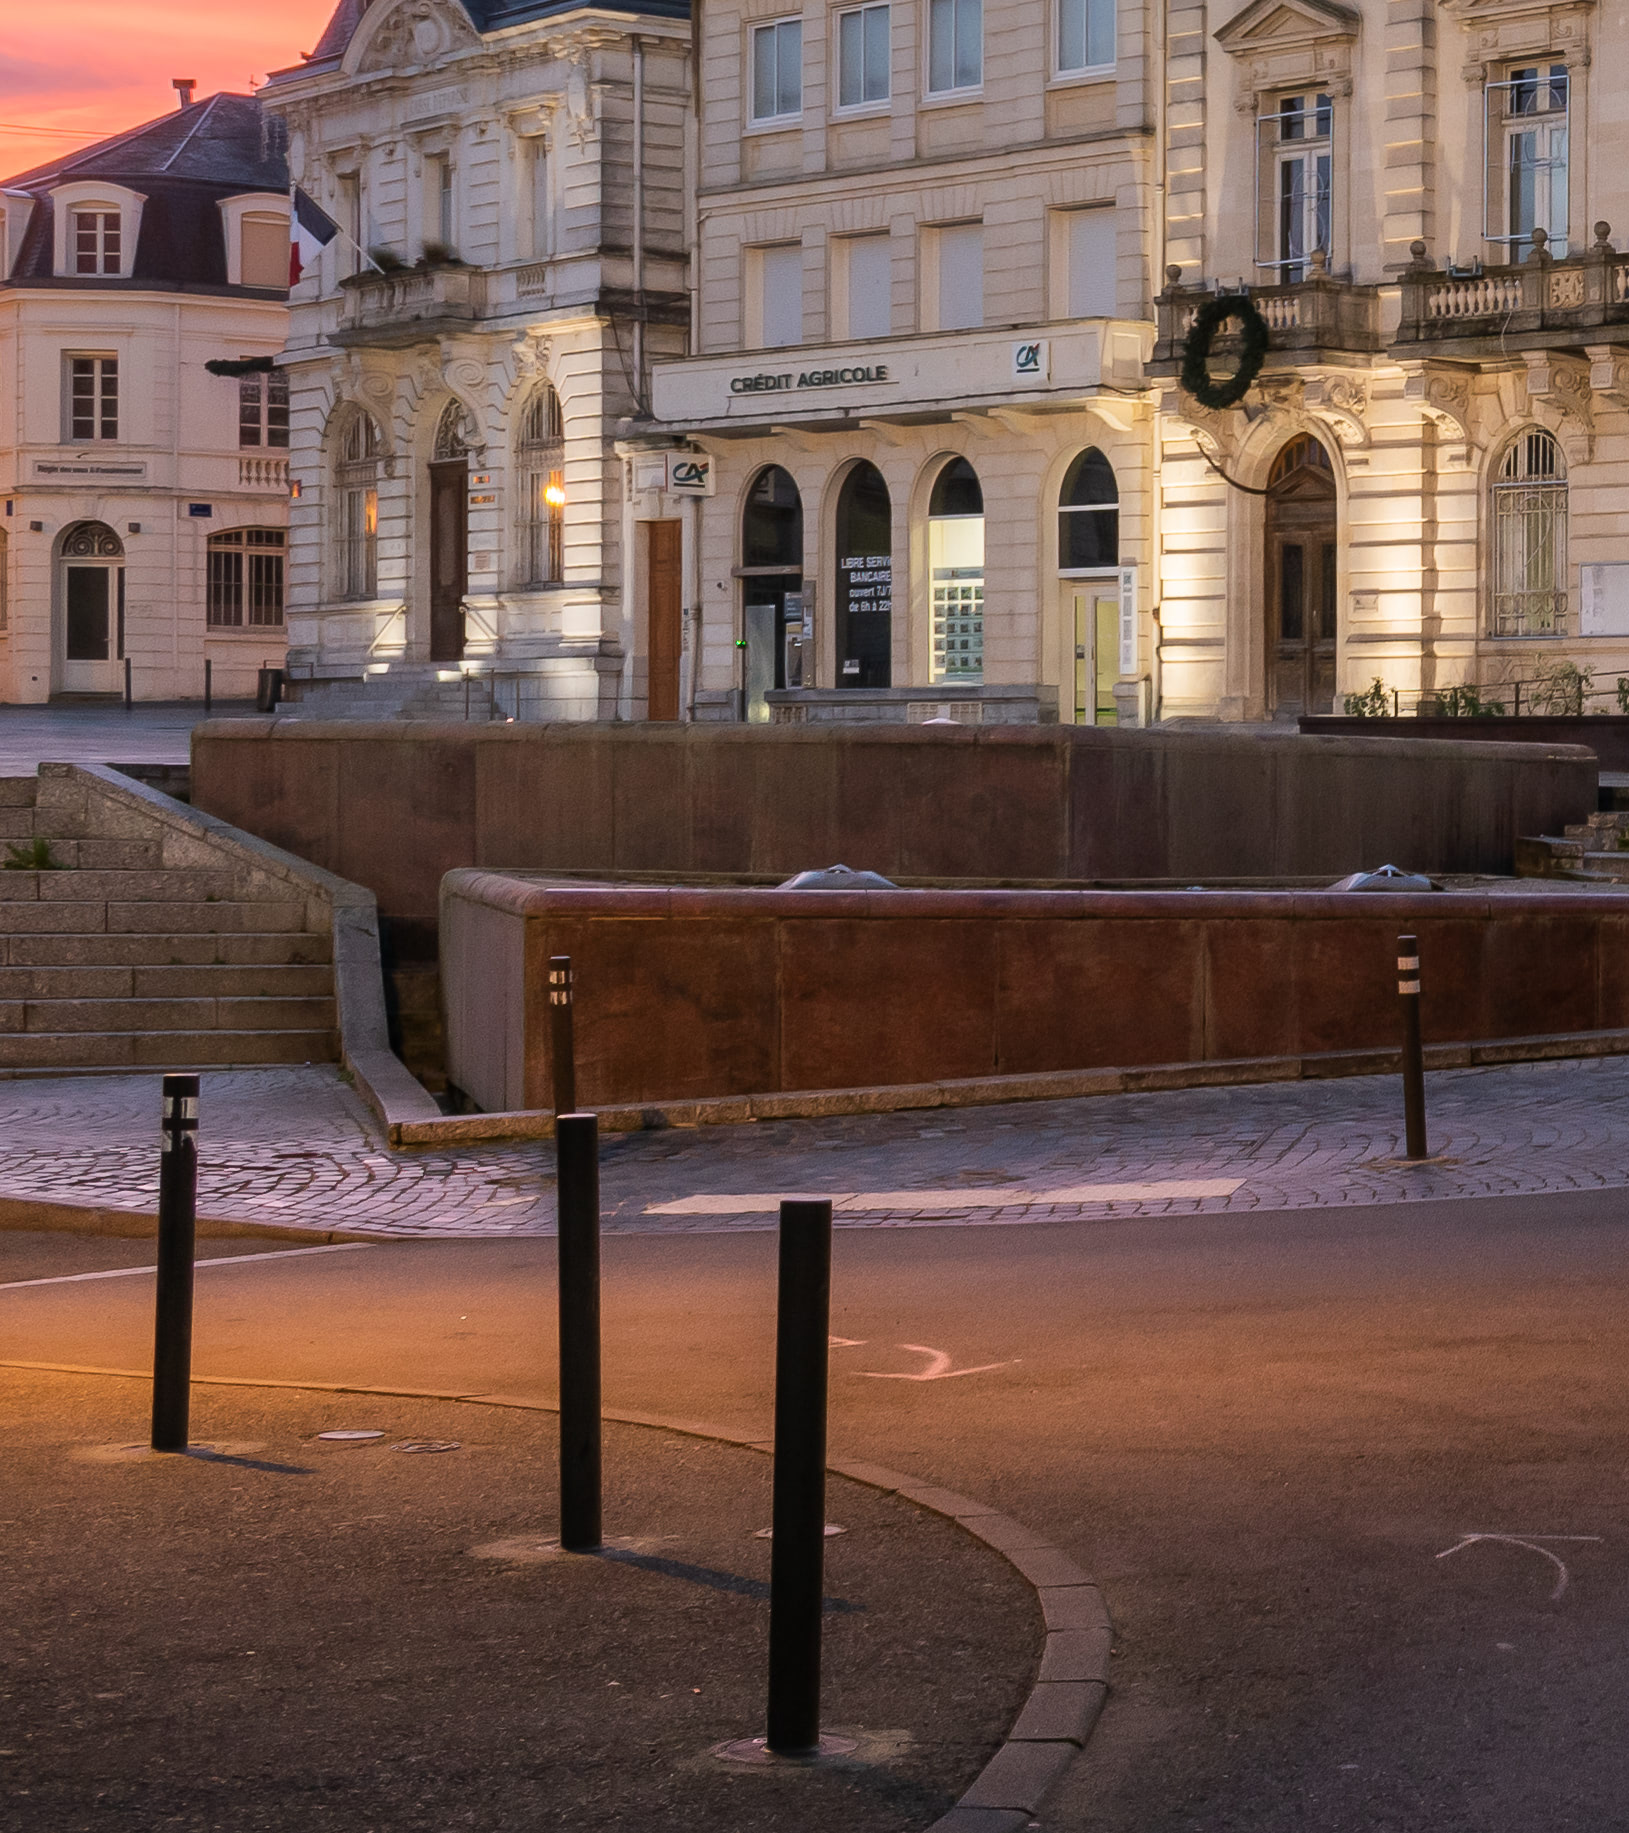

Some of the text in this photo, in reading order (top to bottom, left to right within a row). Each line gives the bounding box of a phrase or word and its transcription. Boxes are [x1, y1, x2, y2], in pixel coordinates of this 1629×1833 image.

[730, 365, 887, 393] CRÉDIT AGRICOLE
[841, 557, 864, 568] LIBRE
[850, 570, 891, 583] BANCAIRE
